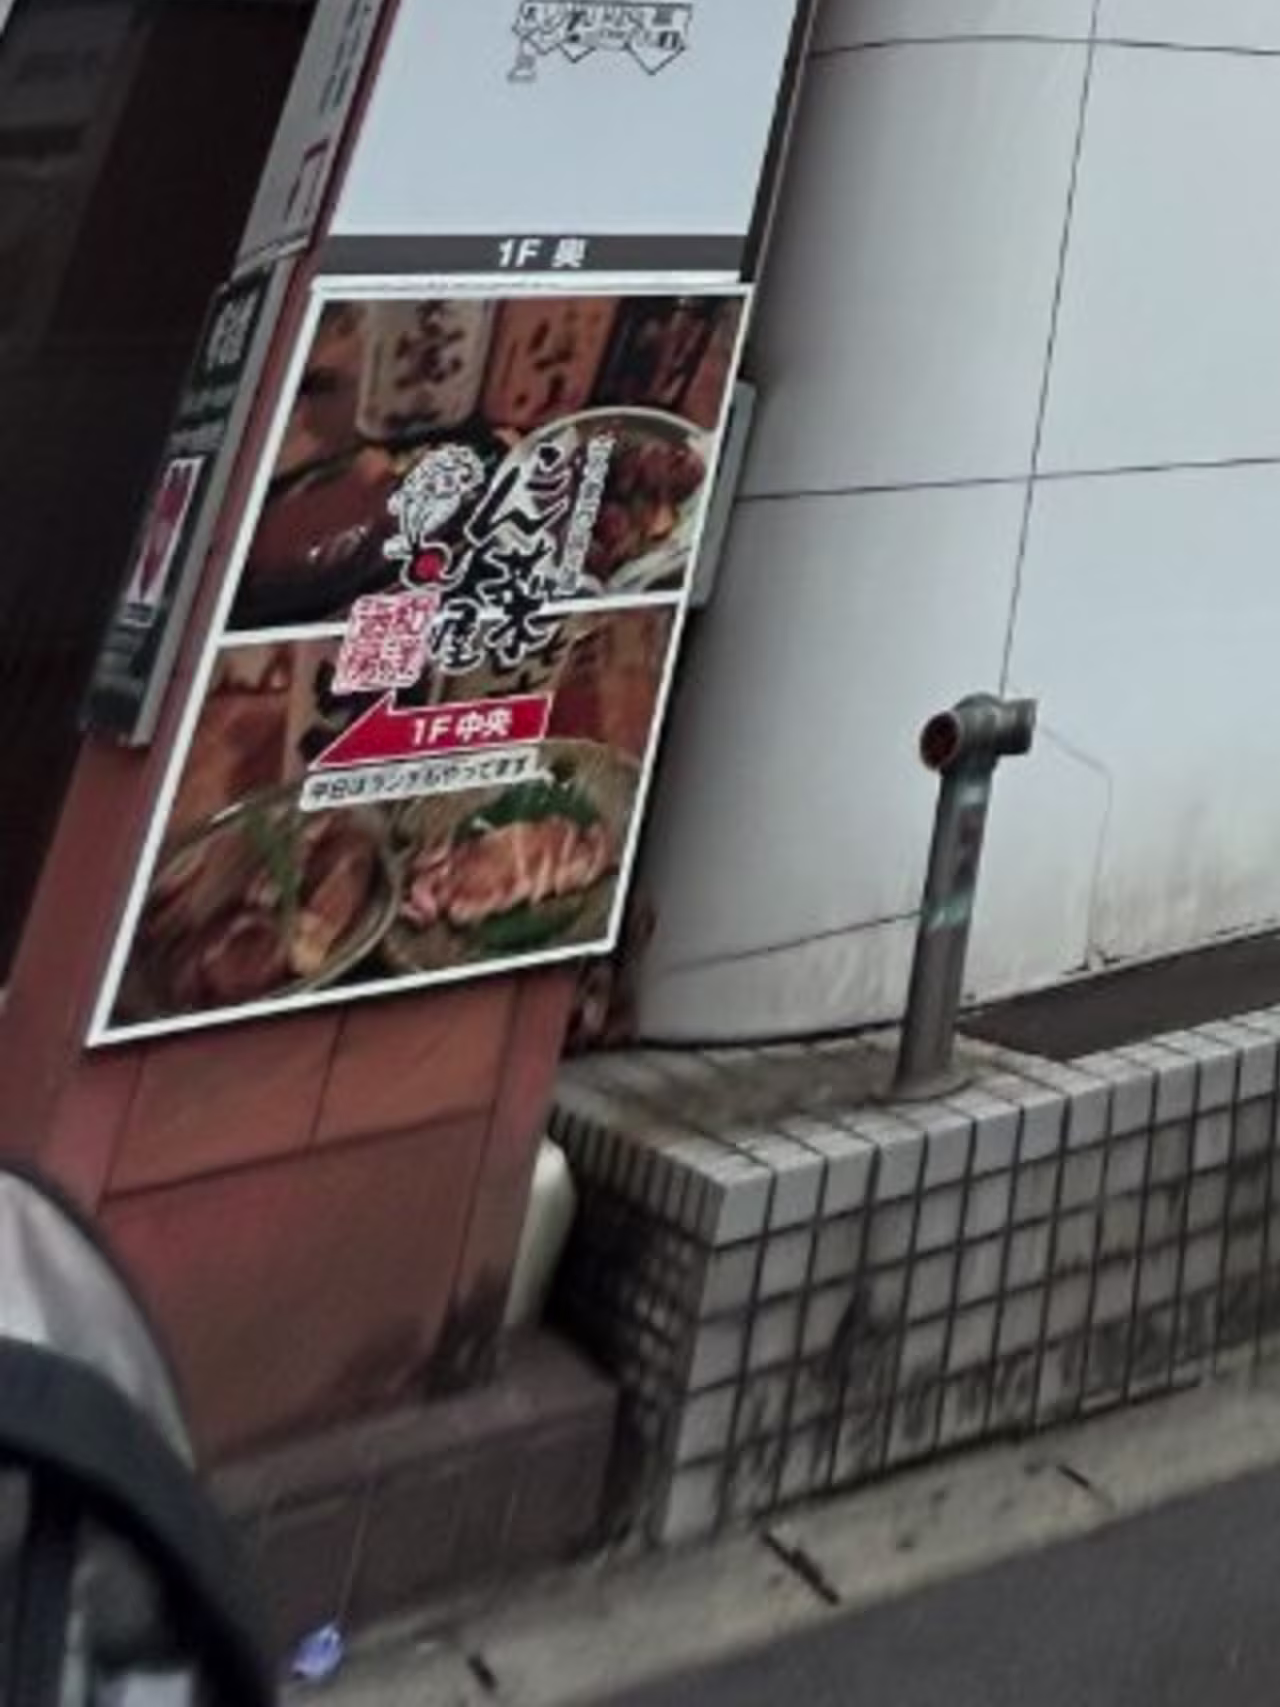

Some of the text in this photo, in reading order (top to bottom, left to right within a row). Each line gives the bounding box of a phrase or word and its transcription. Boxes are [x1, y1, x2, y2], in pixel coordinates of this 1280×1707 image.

[499, 238, 542, 268] 1F
[413, 710, 512, 746] 1F 中央
